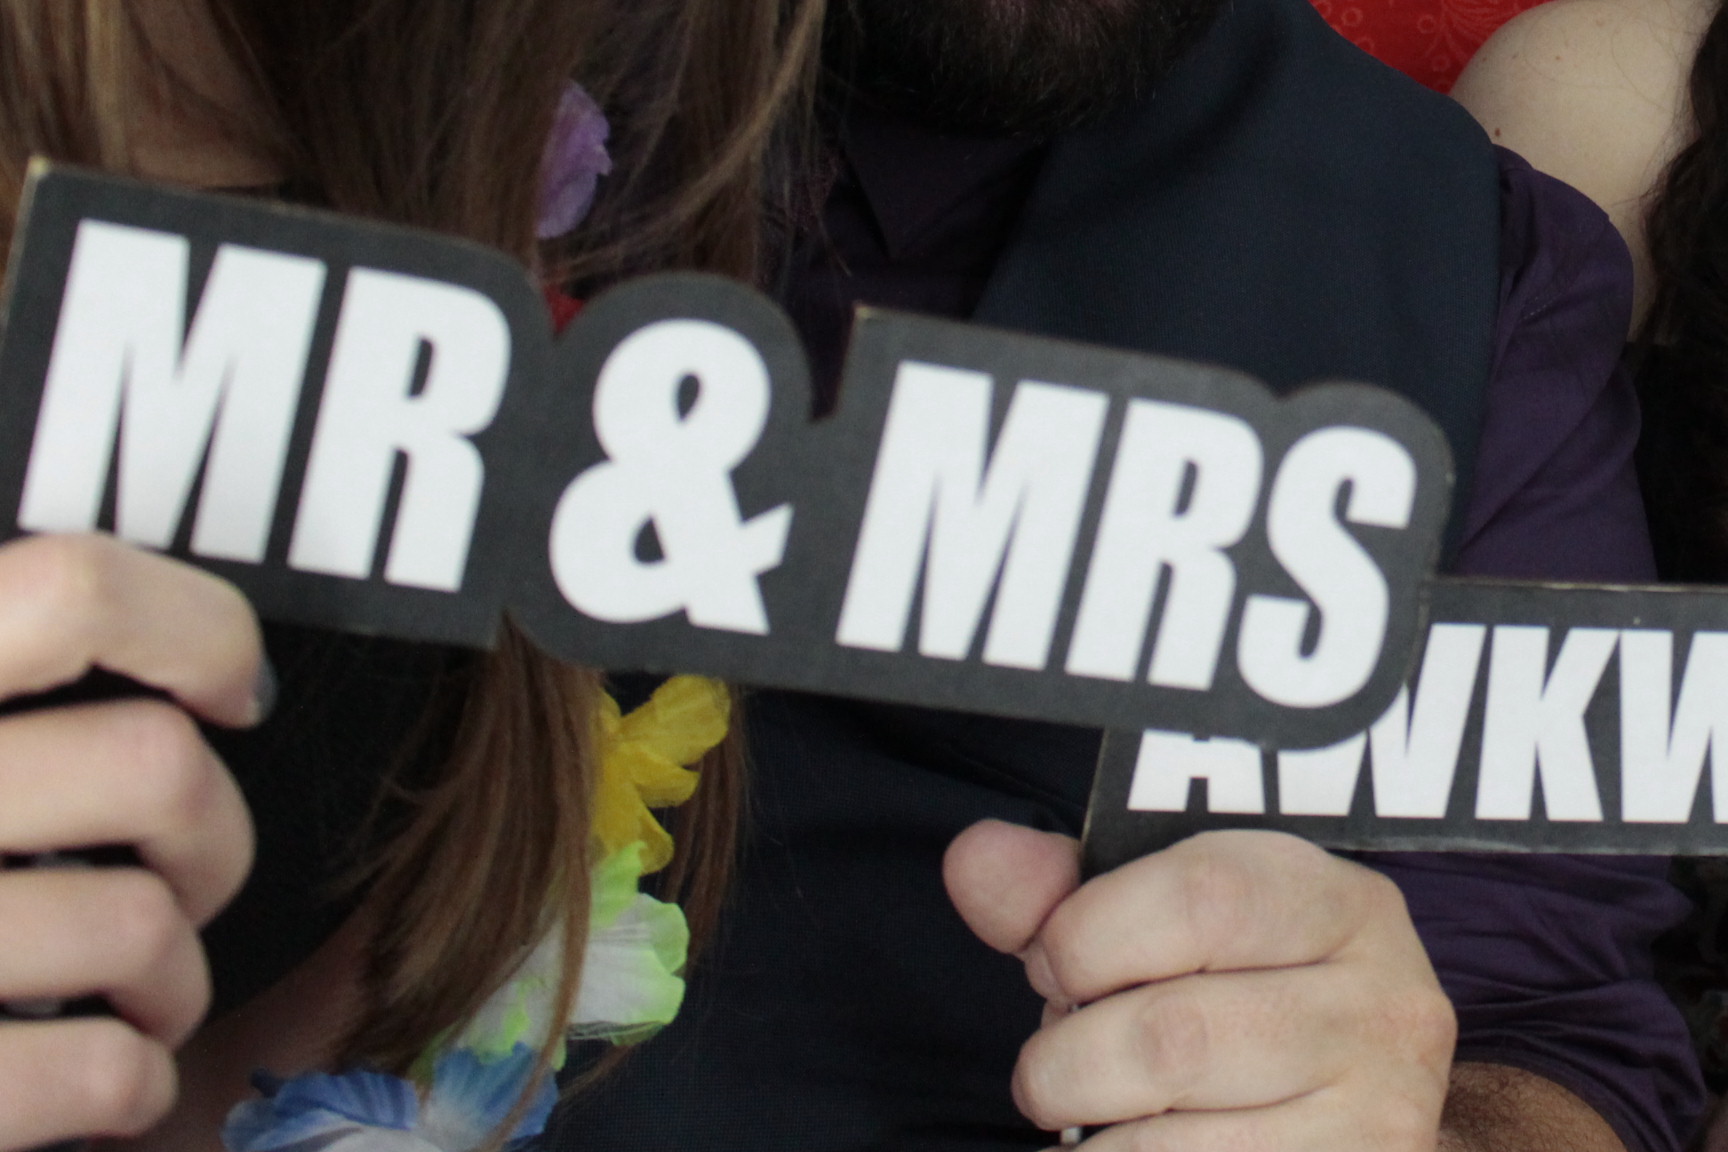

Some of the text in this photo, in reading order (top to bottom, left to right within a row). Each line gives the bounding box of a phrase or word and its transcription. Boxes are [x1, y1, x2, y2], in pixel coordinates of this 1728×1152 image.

[17, 219, 1418, 709] MR & MRS
